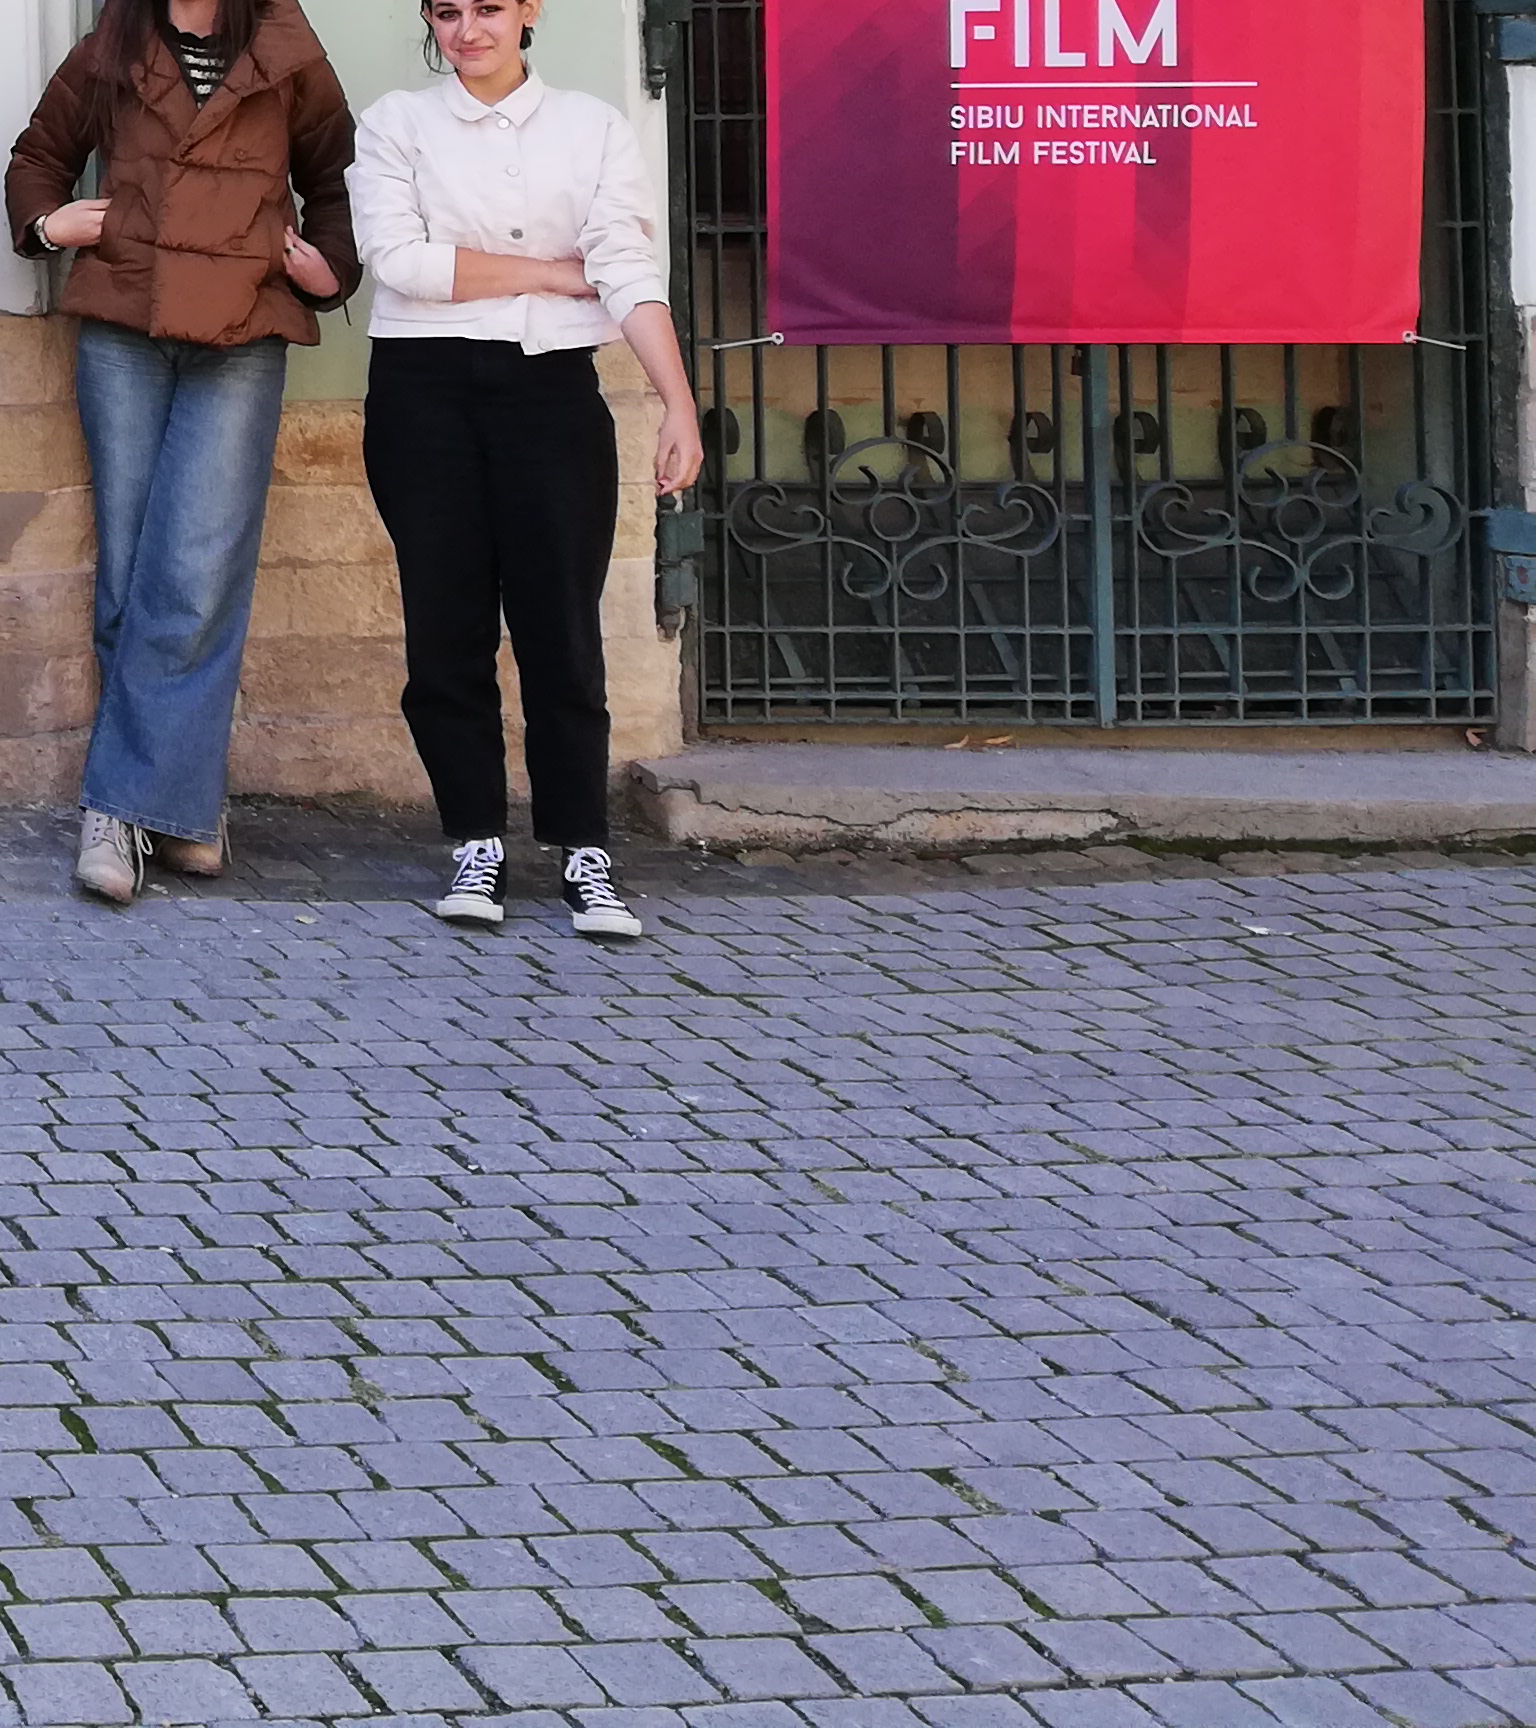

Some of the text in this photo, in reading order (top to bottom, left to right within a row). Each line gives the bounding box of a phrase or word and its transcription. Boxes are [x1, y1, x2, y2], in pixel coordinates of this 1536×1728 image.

[951, 104, 1257, 128] SIBIU INTERNATIONAL
[951, 142, 1156, 164] FILM FESTIVAL
